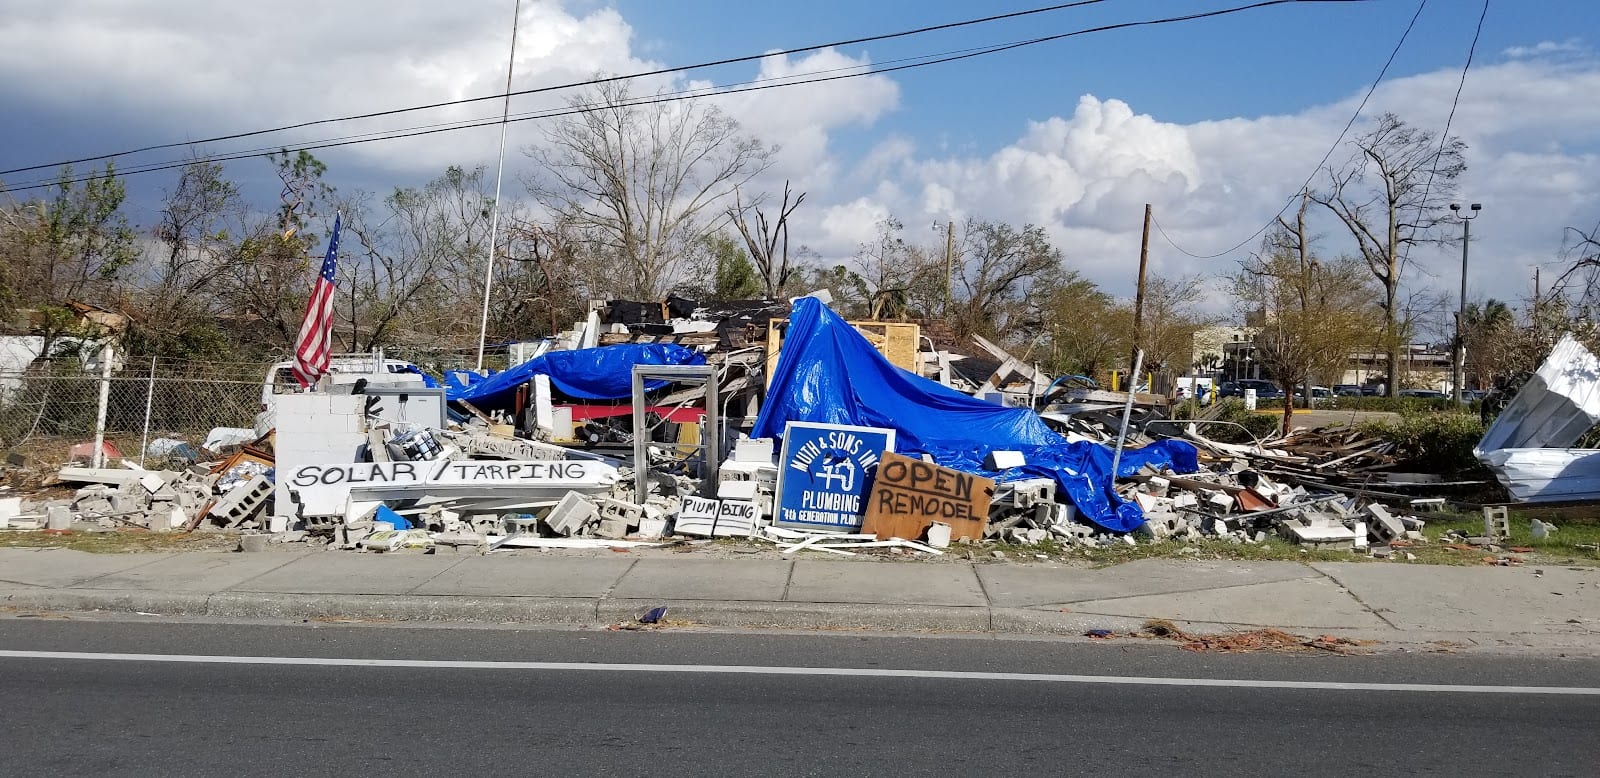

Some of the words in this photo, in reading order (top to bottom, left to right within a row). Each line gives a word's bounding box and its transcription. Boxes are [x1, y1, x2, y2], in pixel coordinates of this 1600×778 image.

[790, 440, 821, 472] MUTH
[818, 436, 828, 449] &
[829, 432, 863, 455] SONS
[292, 462, 417, 487] SOLAR
[453, 463, 586, 480] TARPING
[883, 461, 974, 500] OPEN
[802, 490, 861, 512] PLUMBING
[878, 488, 981, 521] REMODEL
[799, 510, 839, 524] GENERATION
